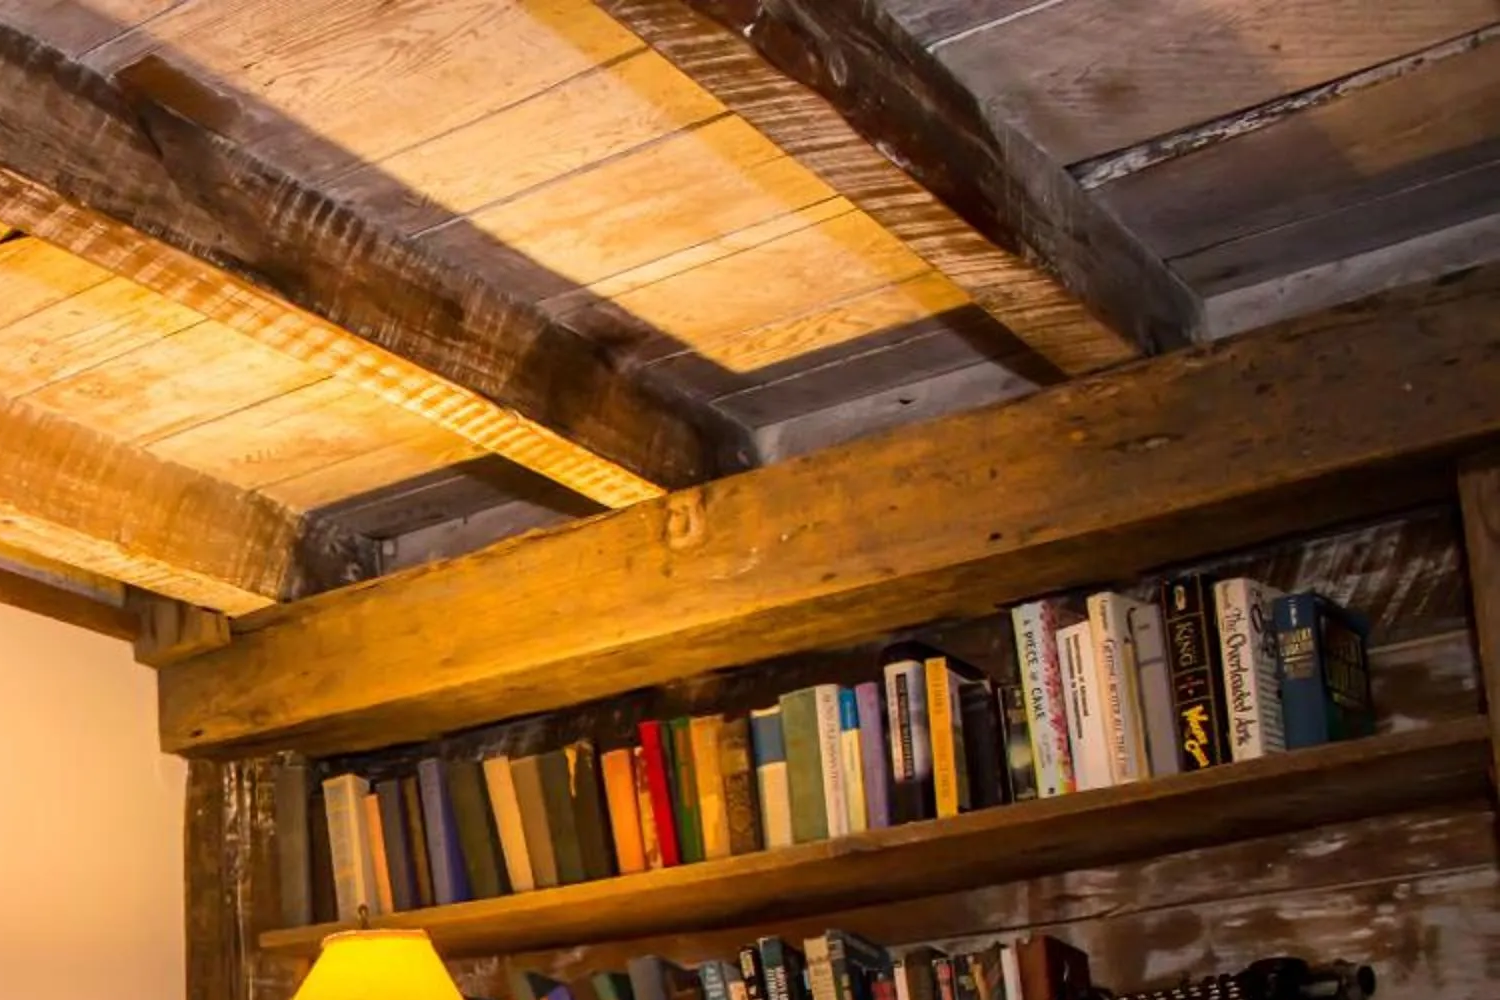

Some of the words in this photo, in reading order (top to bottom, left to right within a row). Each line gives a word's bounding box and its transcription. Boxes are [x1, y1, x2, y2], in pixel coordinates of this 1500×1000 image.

[1226, 608, 1246, 632] The
[1024, 631, 1039, 666] PIECE
[1227, 633, 1252, 712] Overloaded
[1031, 687, 1046, 720] CAKE
[1234, 716, 1257, 746] Ark
